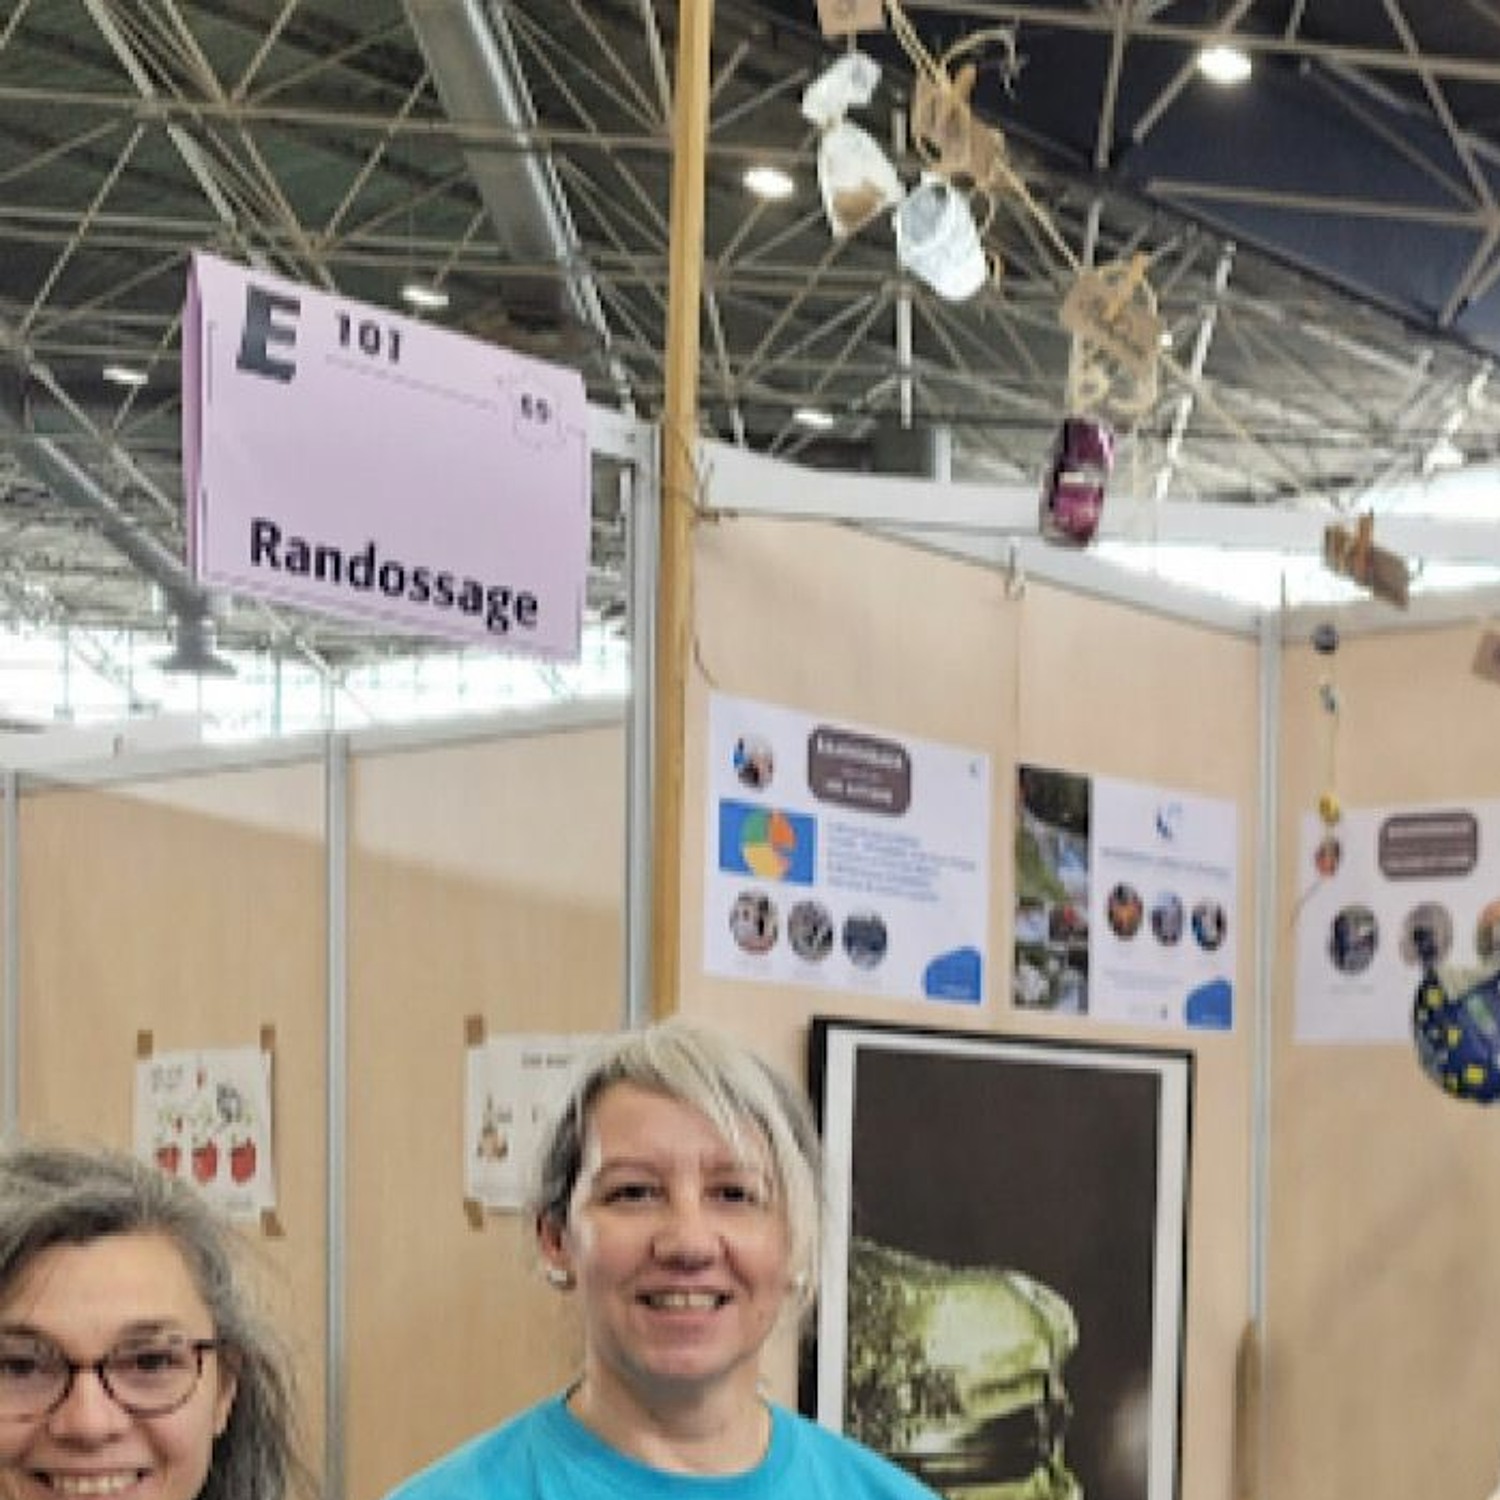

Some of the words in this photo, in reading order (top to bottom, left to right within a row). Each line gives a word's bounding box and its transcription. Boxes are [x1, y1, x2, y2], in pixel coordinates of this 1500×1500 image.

[236, 285, 301, 384] E
[337, 310, 401, 364] 101
[250, 516, 539, 634] Randossage
